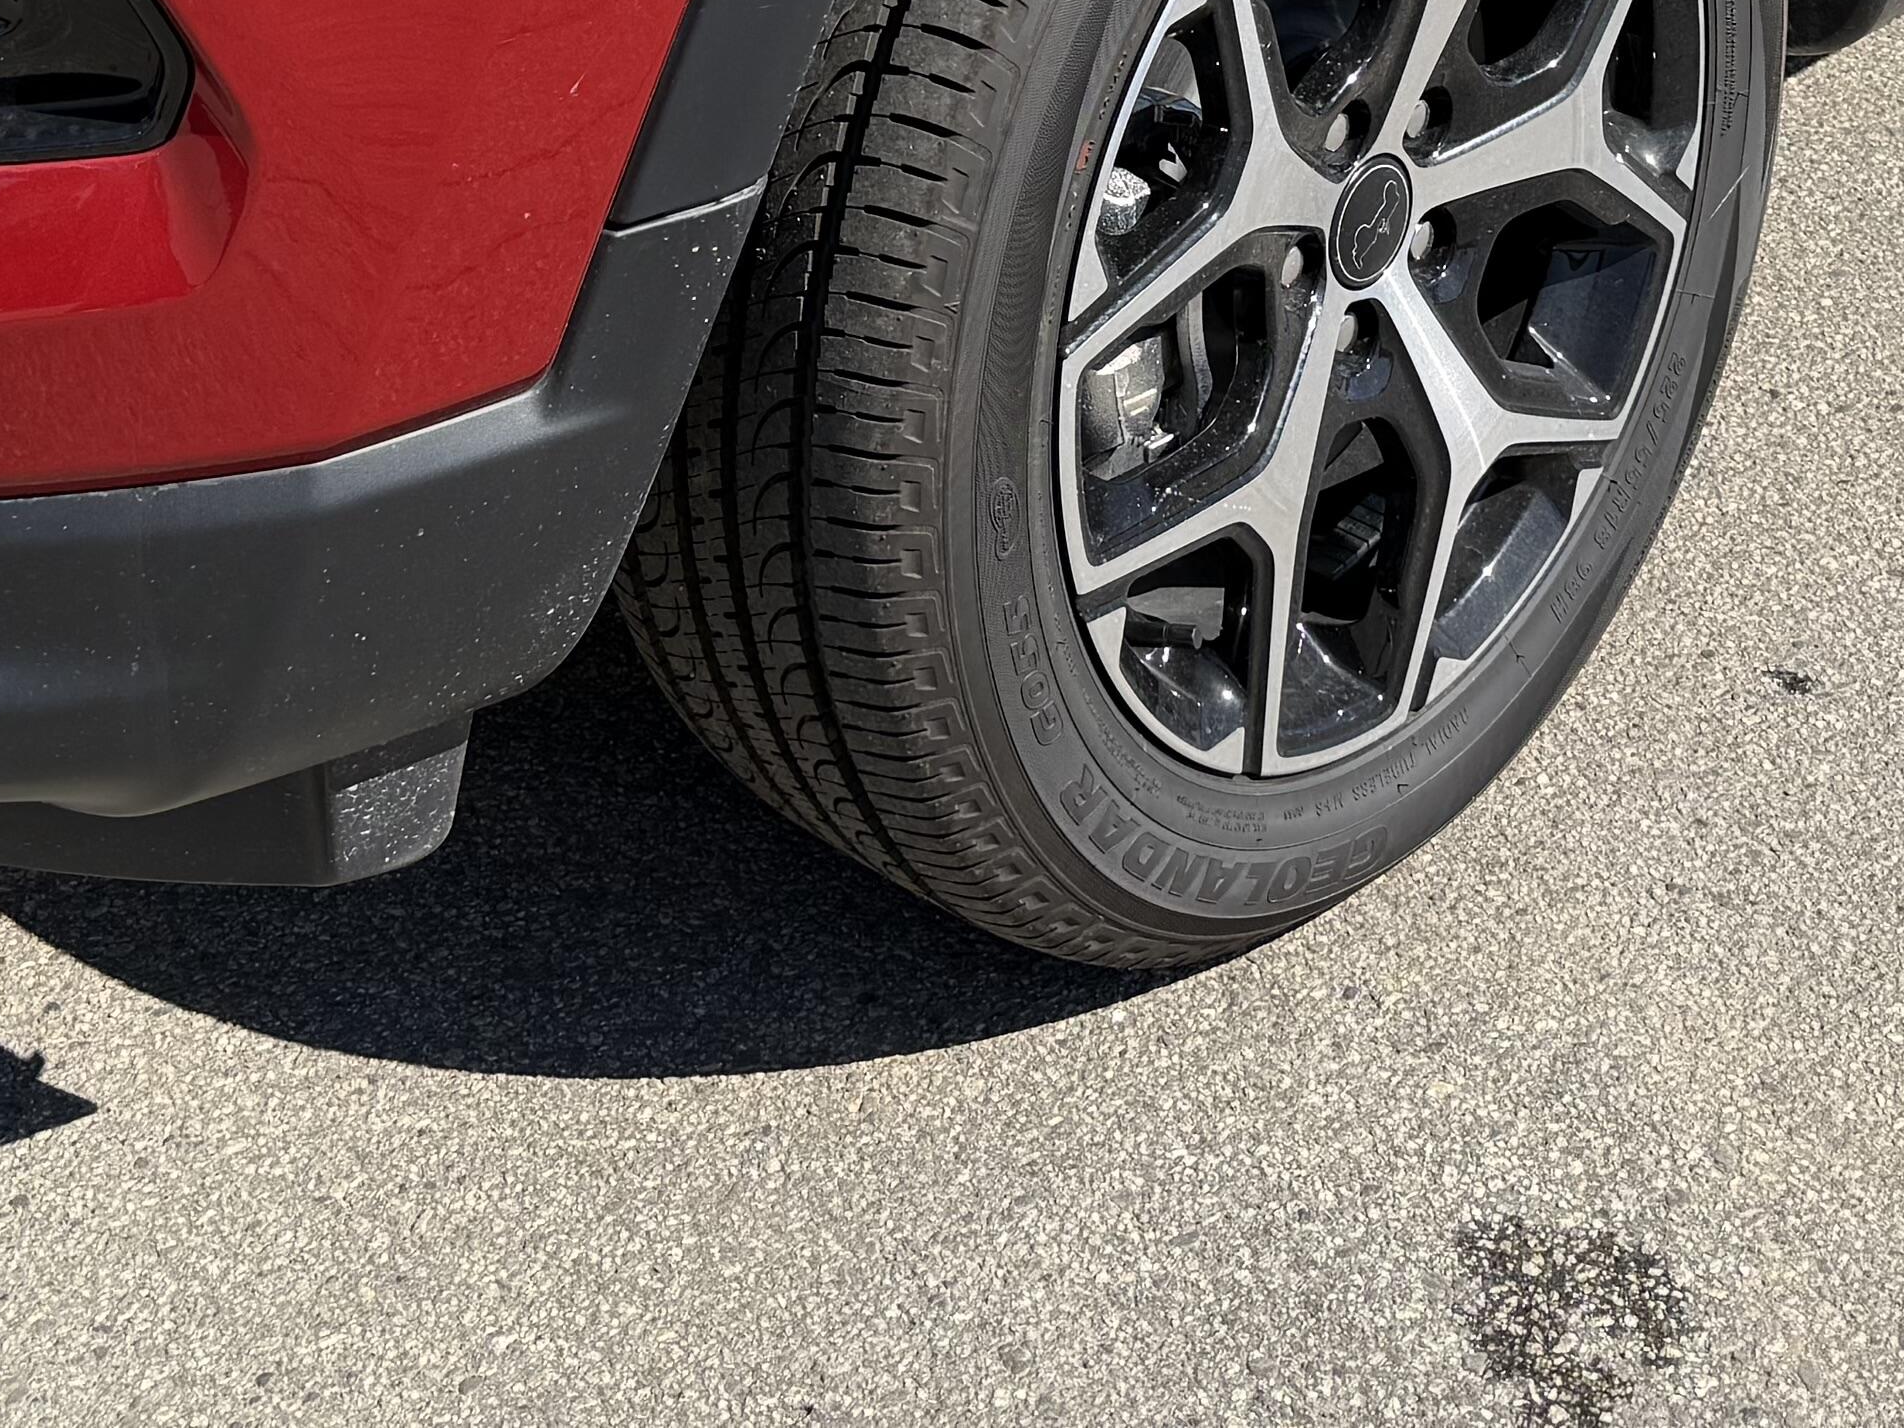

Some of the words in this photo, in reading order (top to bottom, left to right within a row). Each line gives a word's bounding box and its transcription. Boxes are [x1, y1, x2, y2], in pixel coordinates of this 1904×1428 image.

[1594, 352, 1686, 549] 225/55R18
[1002, 594, 1063, 746] G055
[1059, 763, 1390, 906] GEOLANDAR
